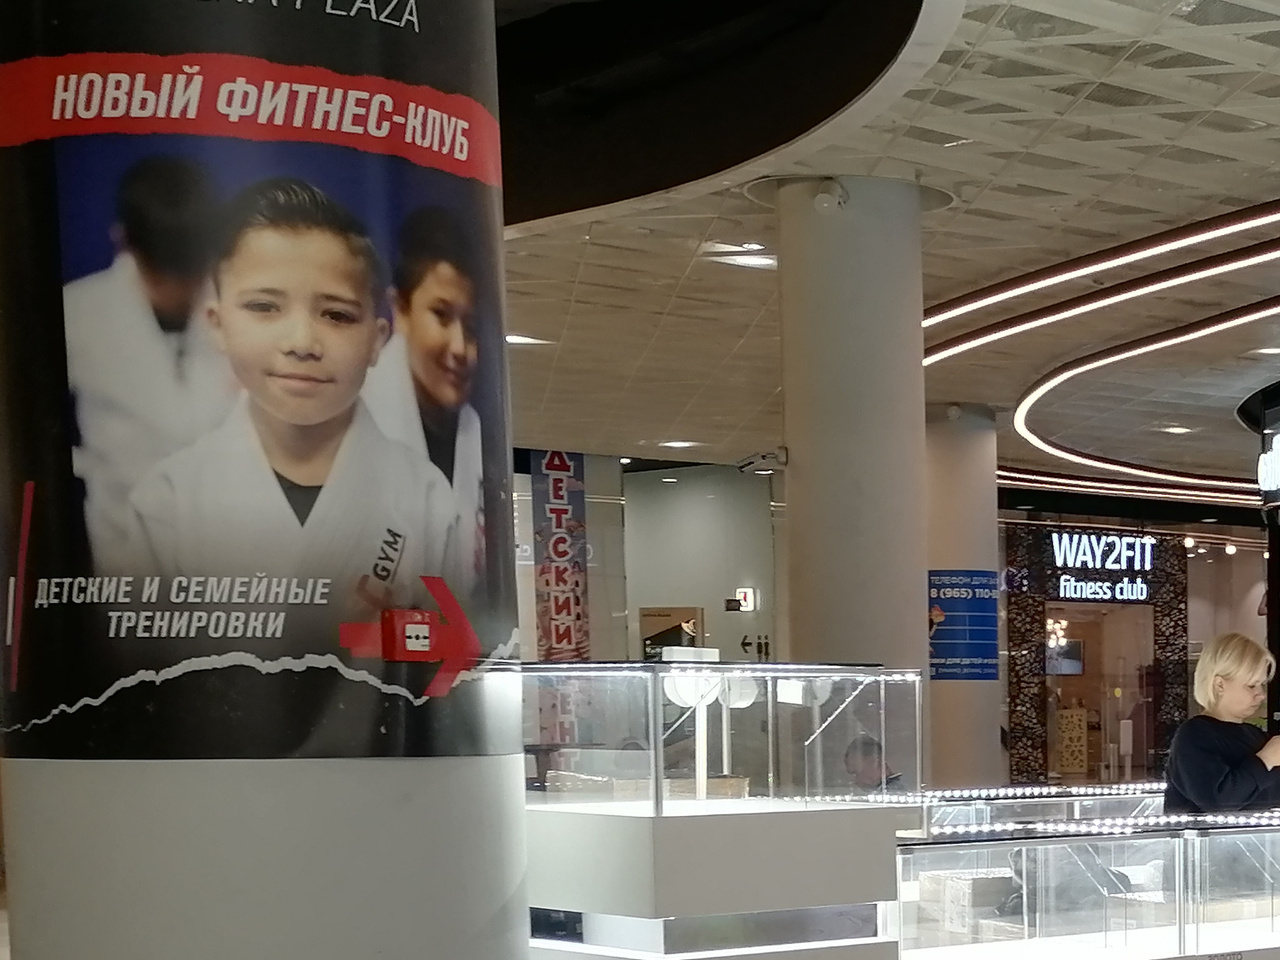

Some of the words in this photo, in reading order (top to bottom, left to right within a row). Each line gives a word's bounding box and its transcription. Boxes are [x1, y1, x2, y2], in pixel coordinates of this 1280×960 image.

[52, 65, 203, 121] НОВЫЙ
[215, 76, 471, 162] ФИТНЕС-КЛУБ
[372, 528, 404, 582] GYM
[1051, 533, 1156, 572] WAY2FIT
[34, 576, 135, 609] ДЕТСКИЕ
[140, 577, 163, 604] И
[169, 572, 333, 606] СЕМЕЙНЫЕ
[1059, 575, 1113, 600] fitness
[1115, 577, 1149, 600] club
[106, 611, 287, 640] ТРЕНИРОВКИ
